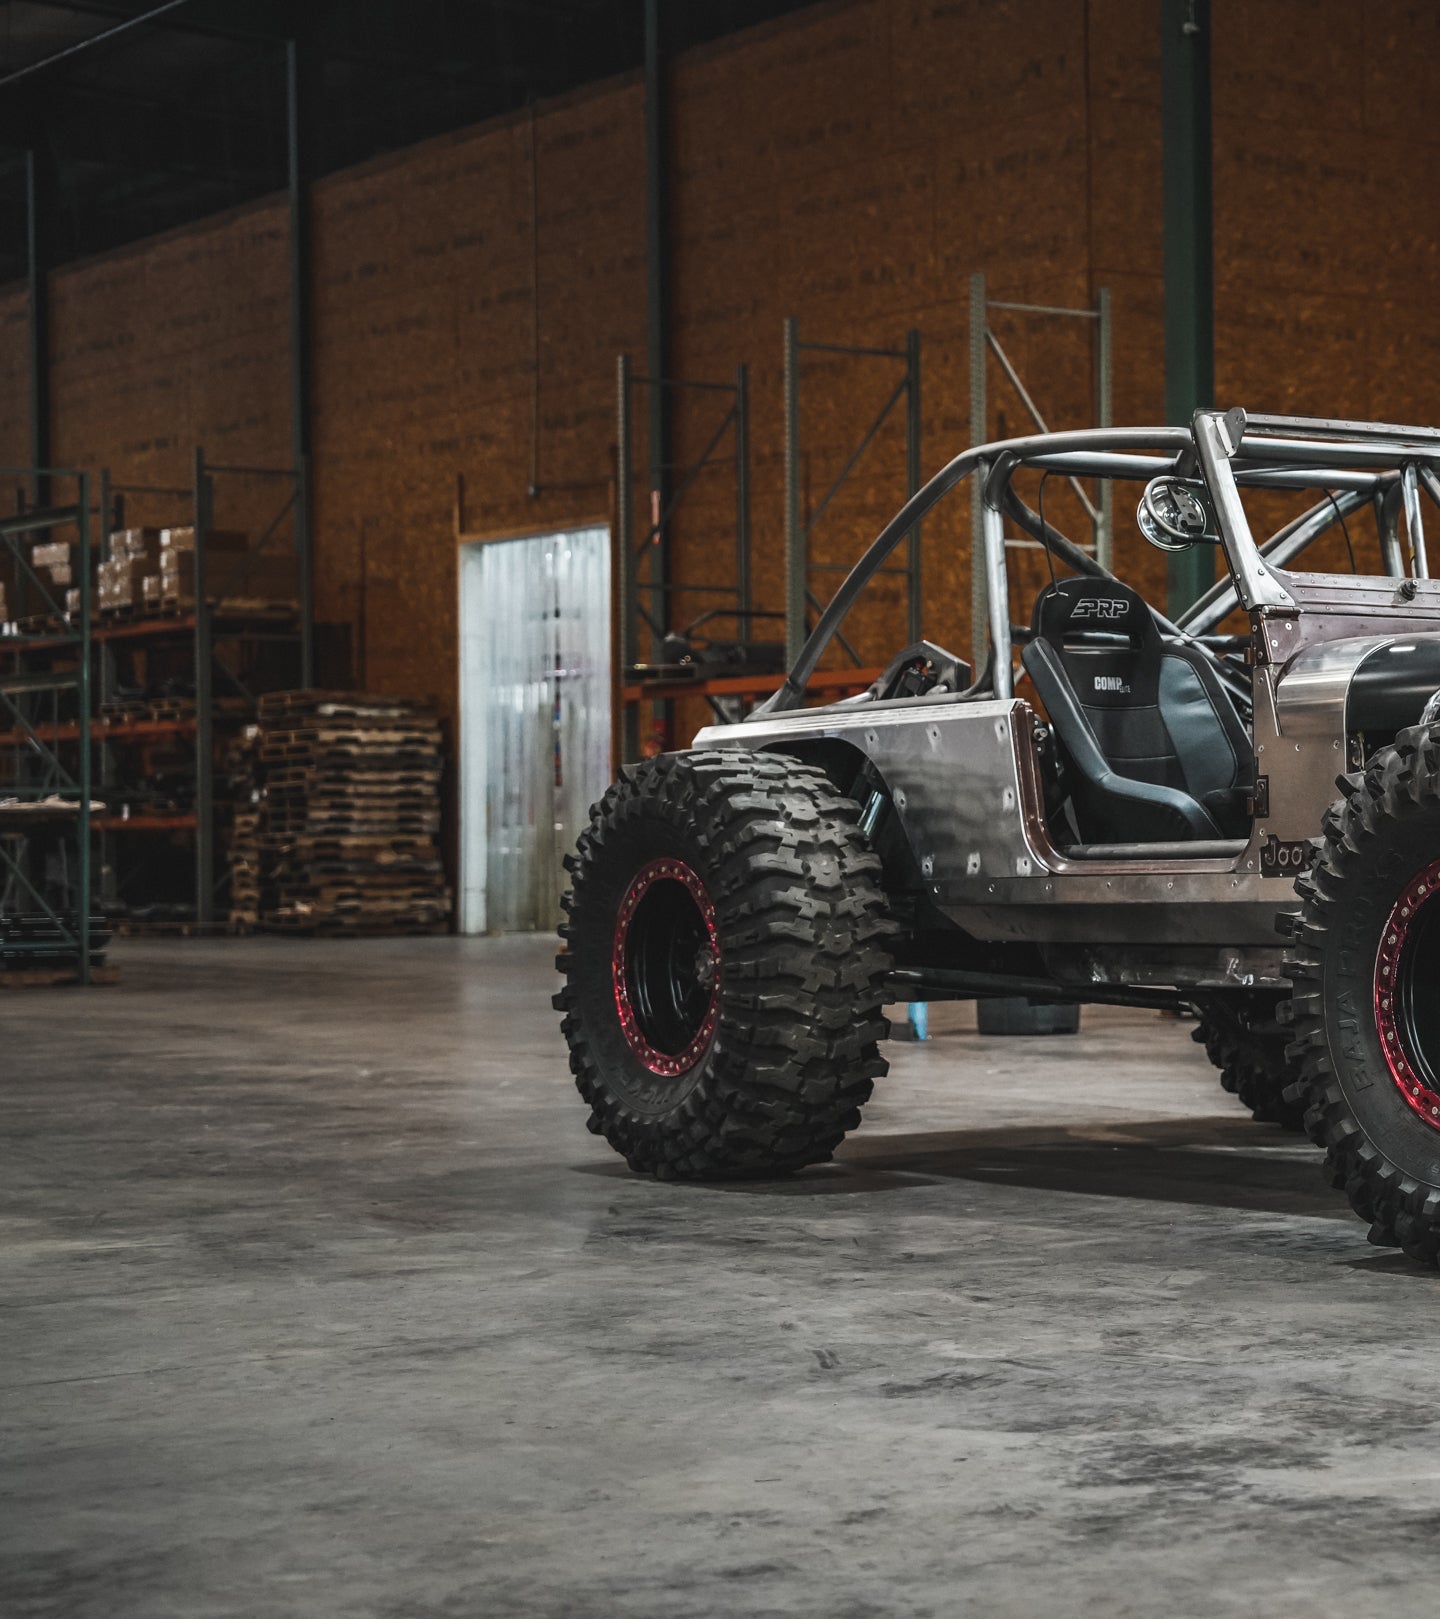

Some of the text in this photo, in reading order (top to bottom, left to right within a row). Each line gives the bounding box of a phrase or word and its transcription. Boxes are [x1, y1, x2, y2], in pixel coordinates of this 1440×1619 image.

[1070, 599, 1129, 618] PRP
[1094, 676, 1122, 690] COMP
[1336, 990, 1374, 1092] BAJA
